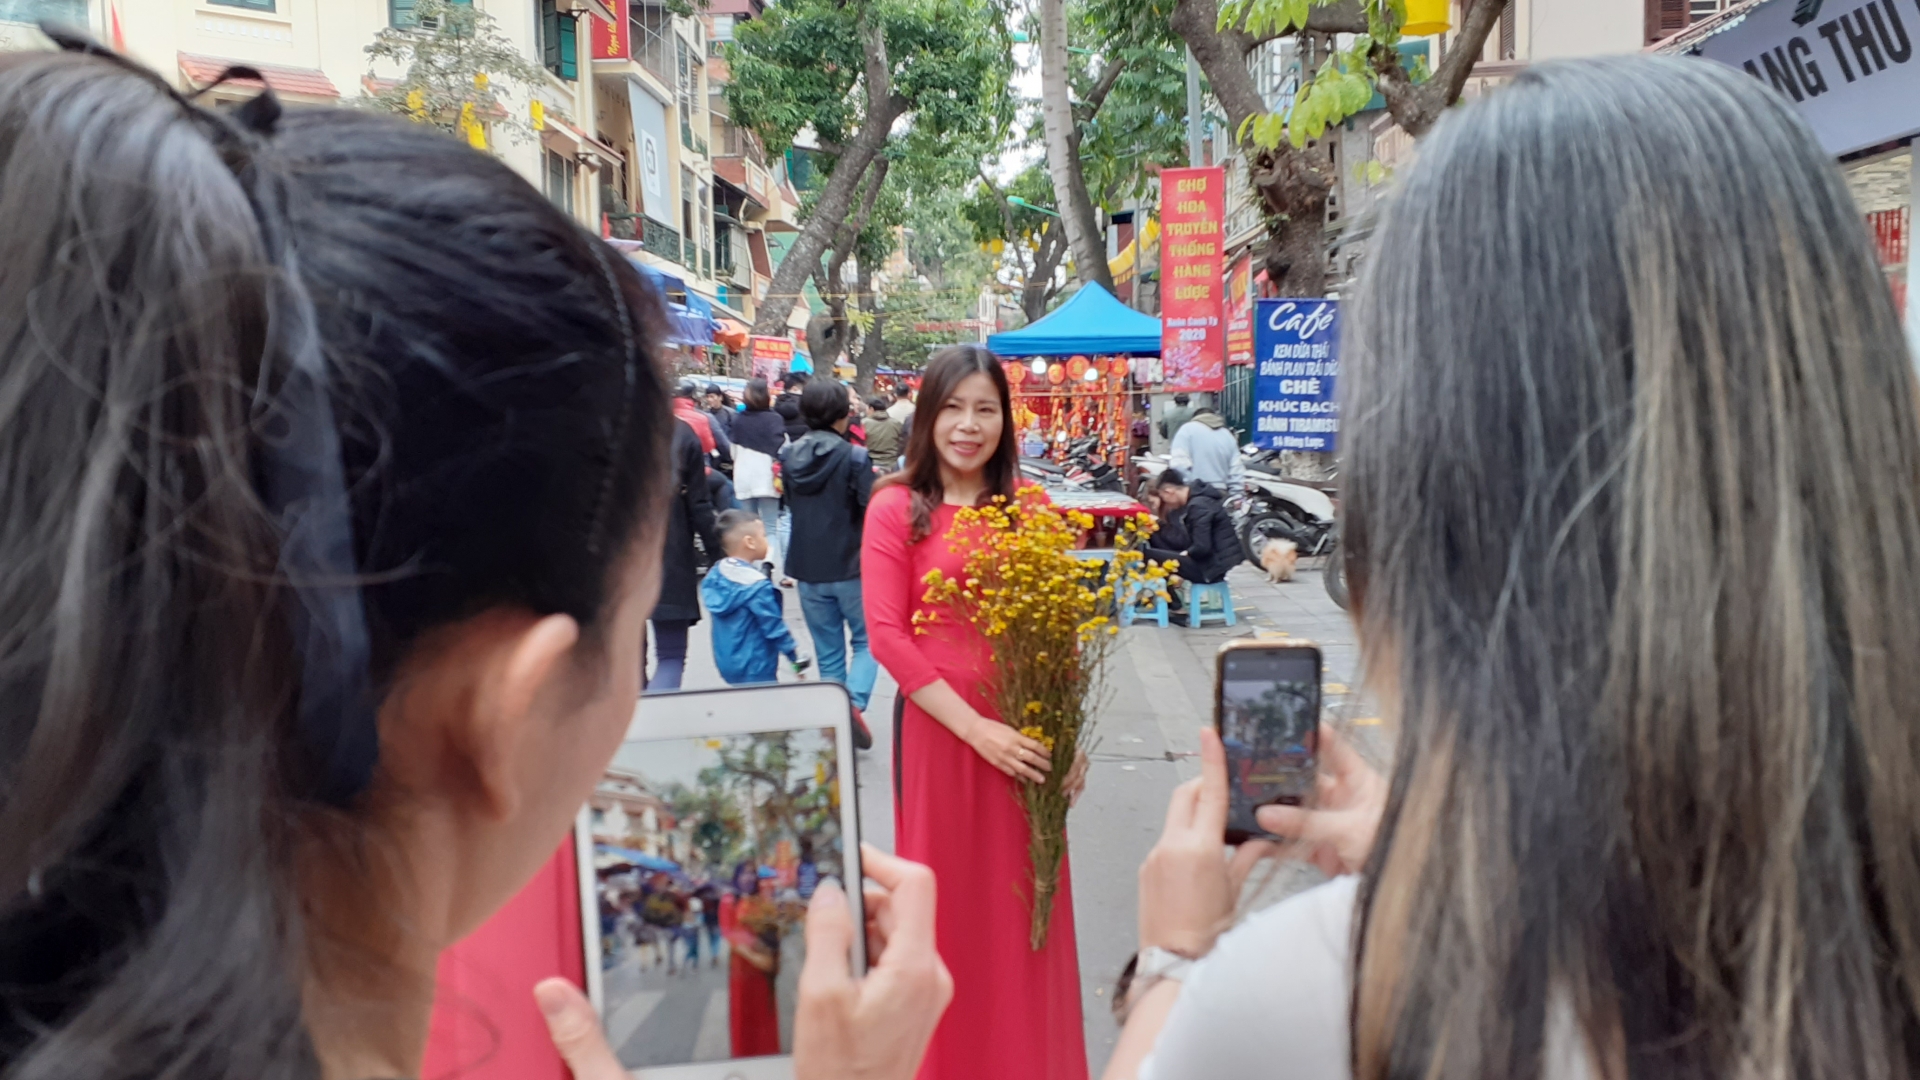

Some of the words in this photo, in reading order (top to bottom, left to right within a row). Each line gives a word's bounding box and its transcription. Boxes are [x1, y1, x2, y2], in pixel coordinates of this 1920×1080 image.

[1177, 176, 1207, 194] CHỢ
[1177, 200, 1206, 214] HOA
[1169, 239, 1215, 257] THỐNG
[1173, 262, 1211, 277] HÀNG
[1175, 284, 1210, 301] LƯỢC
[1269, 302, 1336, 340] Café
[1179, 328, 1206, 341] 2020
[1273, 344, 1292, 359] KEM
[1260, 358, 1284, 376] BÁNH
[1258, 398, 1300, 413] KHÚC
[1257, 414, 1288, 432] BÁNH
